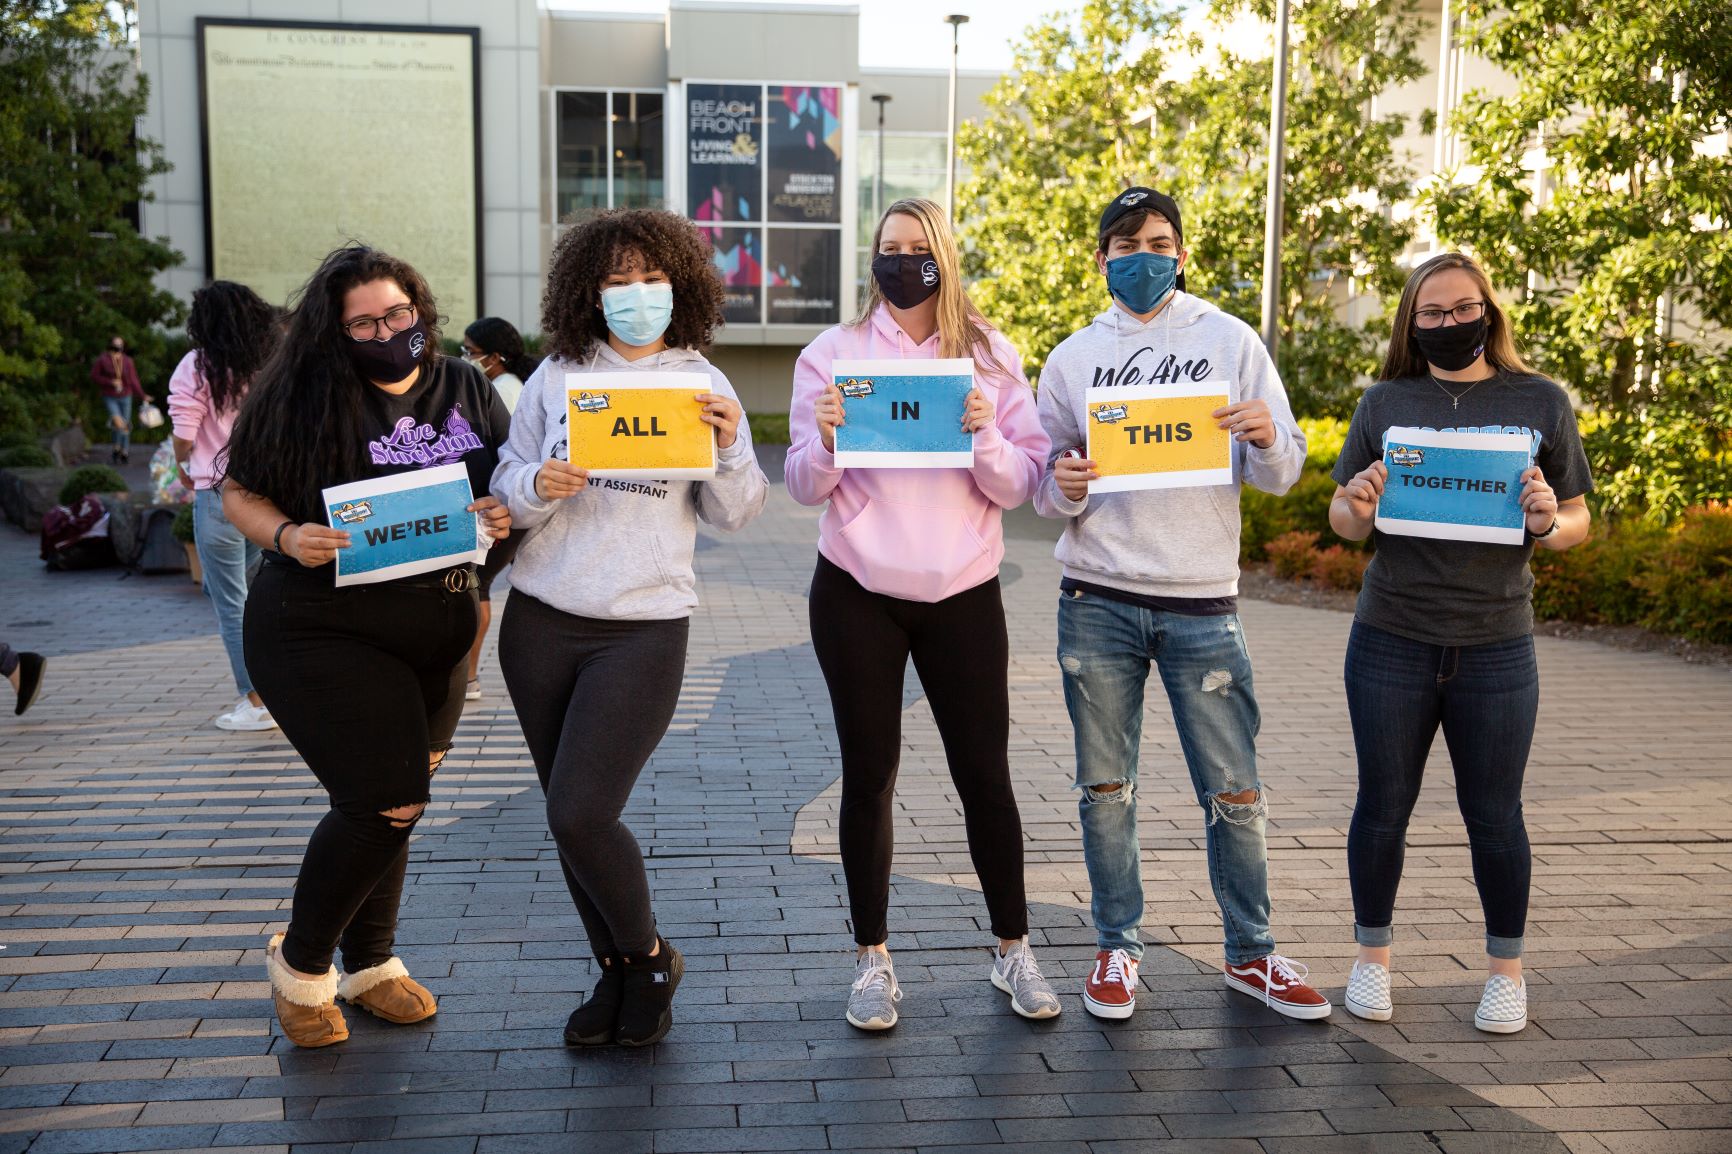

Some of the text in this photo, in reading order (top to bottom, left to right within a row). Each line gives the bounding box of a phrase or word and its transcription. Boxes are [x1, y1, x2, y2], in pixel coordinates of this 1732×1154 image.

[690, 100, 756, 117] BEACH
[690, 117, 752, 133] FRONT
[891, 401, 920, 420] IN
[381, 416, 437, 452] Live
[610, 416, 667, 437] ALL
[1123, 422, 1193, 445] THIS
[369, 432, 484, 465] Stockton
[603, 479, 669, 500] ASSISTANT
[1400, 474, 1507, 494] TOGETHER
[364, 514, 449, 547] WE'RE
